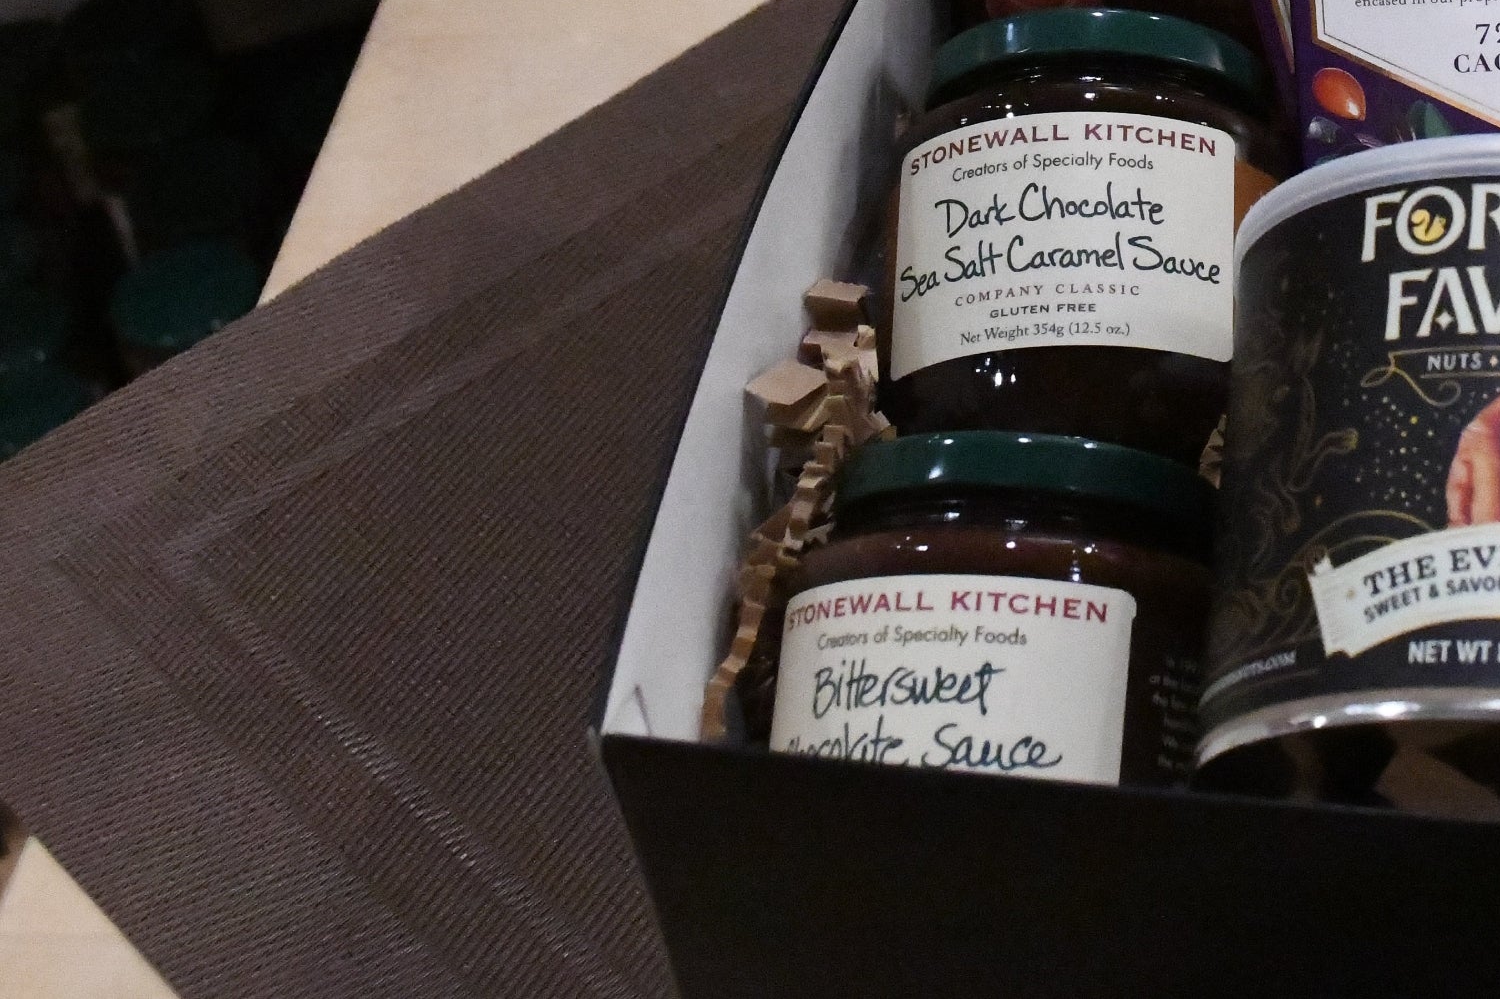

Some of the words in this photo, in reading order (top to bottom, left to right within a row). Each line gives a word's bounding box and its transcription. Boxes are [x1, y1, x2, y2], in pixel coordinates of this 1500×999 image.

[910, 124, 1070, 176] STONEWALL
[1084, 123, 1217, 157] KITCHEN
[952, 159, 1008, 182] Creators
[1013, 155, 1028, 171] of
[1032, 152, 1103, 171] Specialty
[1108, 152, 1154, 171] Foods
[935, 194, 1017, 239] Dark
[1018, 181, 1165, 225] Chocolate
[900, 266, 941, 303] Sea
[944, 240, 1004, 284] Salt
[1006, 231, 1125, 273] Caramel
[1128, 235, 1221, 285] Sauce
[955, 284, 1044, 307] COMPANY
[1055, 284, 1141, 296] CLASSIC
[989, 304, 1050, 319] GLUTEN
[1057, 303, 1097, 313] FREE
[960, 331, 981, 346] Net
[984, 326, 1029, 341] Weight
[1033, 324, 1065, 340] 354g
[1068, 322, 1101, 336] (12.5
[1106, 323, 1131, 337] oz.)
[1427, 353, 1482, 373] NUTS
[1363, 555, 1438, 597] THE
[785, 591, 934, 631] STONEWALL
[950, 590, 1109, 623] KITCHEN
[1363, 586, 1422, 624] SWEET
[1429, 585, 1439, 598] &
[817, 632, 869, 651] Creators
[873, 625, 890, 644] of
[894, 624, 969, 647] Specialty
[974, 625, 1028, 646] Foods
[1408, 640, 1452, 664] NET
[1456, 640, 1492, 663] WT
[811, 660, 1006, 719] Bittersweet
[921, 722, 1063, 771] Sauce
